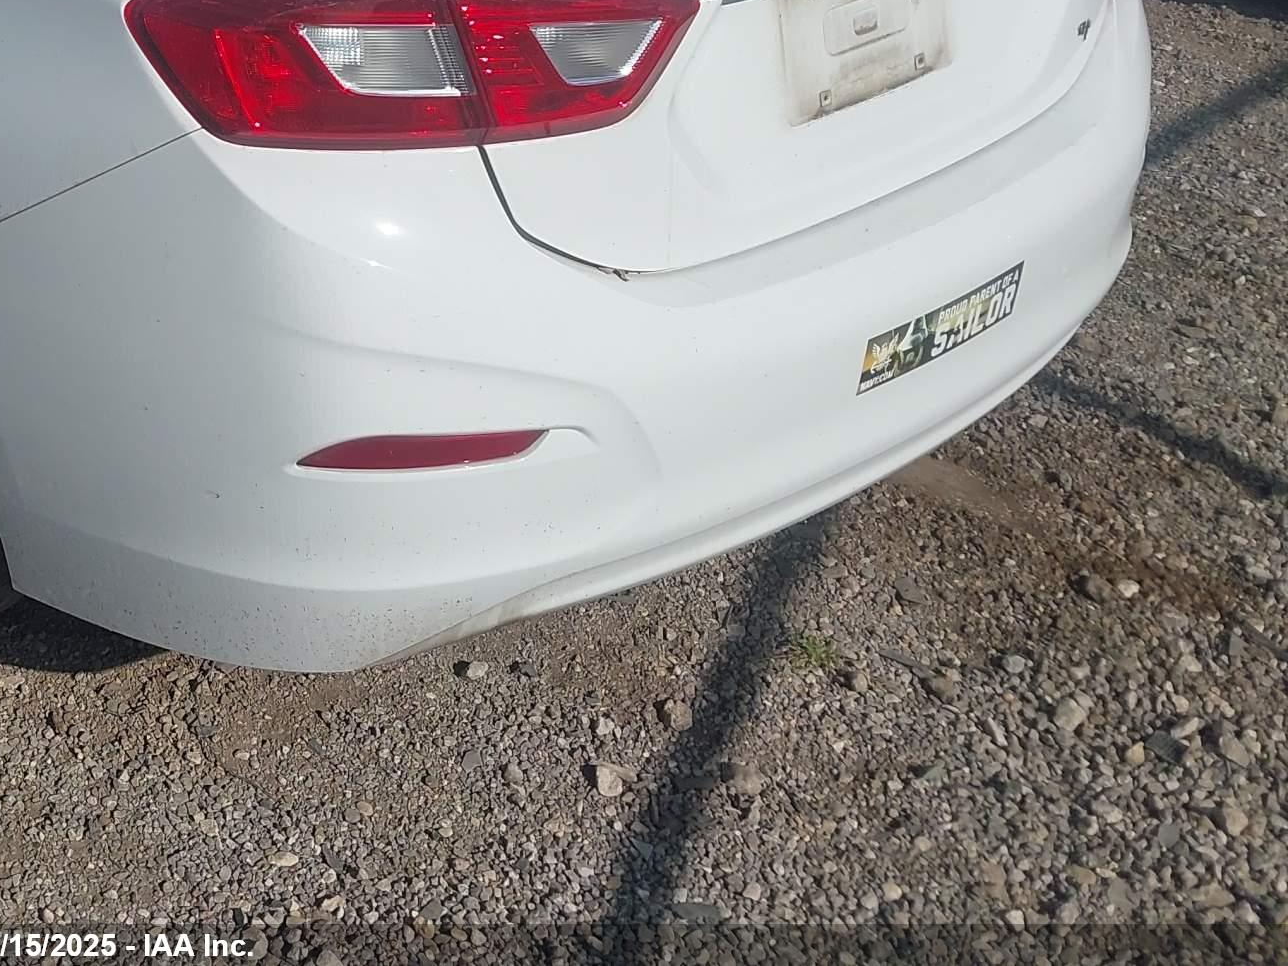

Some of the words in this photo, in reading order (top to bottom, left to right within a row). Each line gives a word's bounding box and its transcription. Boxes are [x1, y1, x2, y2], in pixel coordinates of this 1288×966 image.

[930, 283, 1017, 357] SAILOR
[938, 299, 968, 324] PROUD
[969, 280, 1002, 308] PARENT
[1002, 273, 1014, 289] OF
[1012, 269, 1019, 283] A
